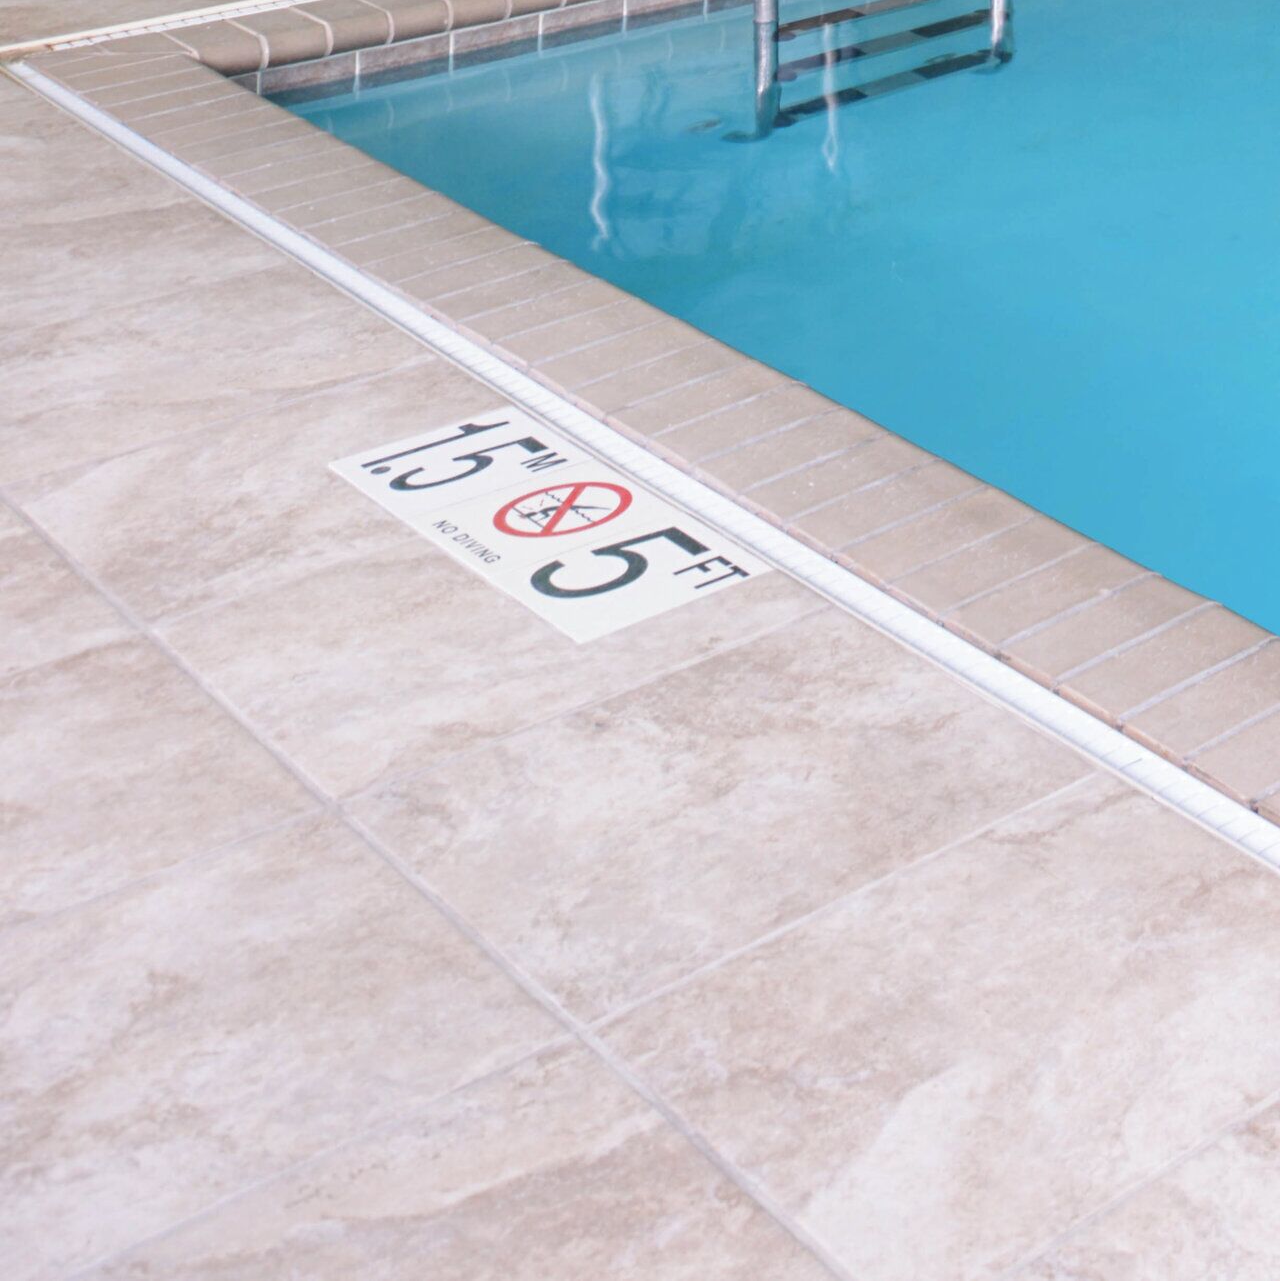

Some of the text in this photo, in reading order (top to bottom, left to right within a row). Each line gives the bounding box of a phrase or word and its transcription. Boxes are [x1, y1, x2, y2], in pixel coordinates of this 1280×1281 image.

[361, 421, 569, 492] 1.5 M
[432, 518, 501, 566] NO DIVING
[530, 526, 750, 600] 5 FT
